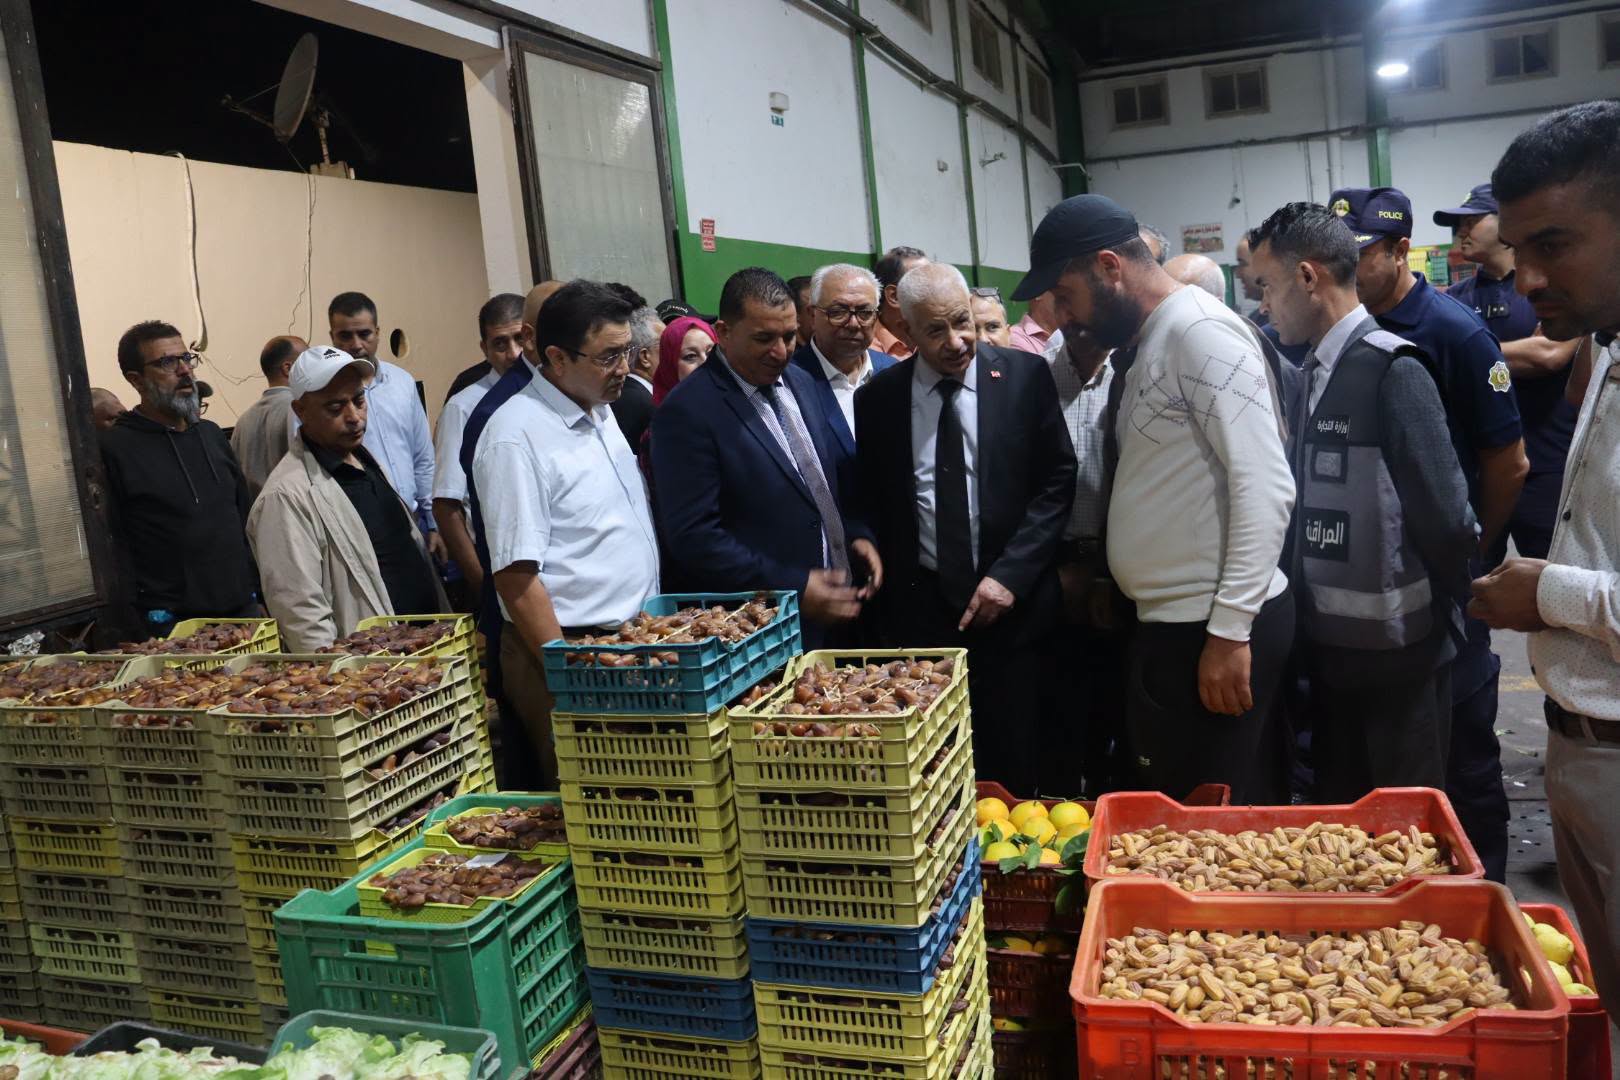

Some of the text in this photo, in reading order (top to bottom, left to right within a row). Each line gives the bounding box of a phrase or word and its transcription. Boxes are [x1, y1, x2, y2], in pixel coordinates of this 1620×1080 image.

[1378, 210, 1403, 220] POLICE
[1317, 420, 1348, 434] وزارة التجارة
